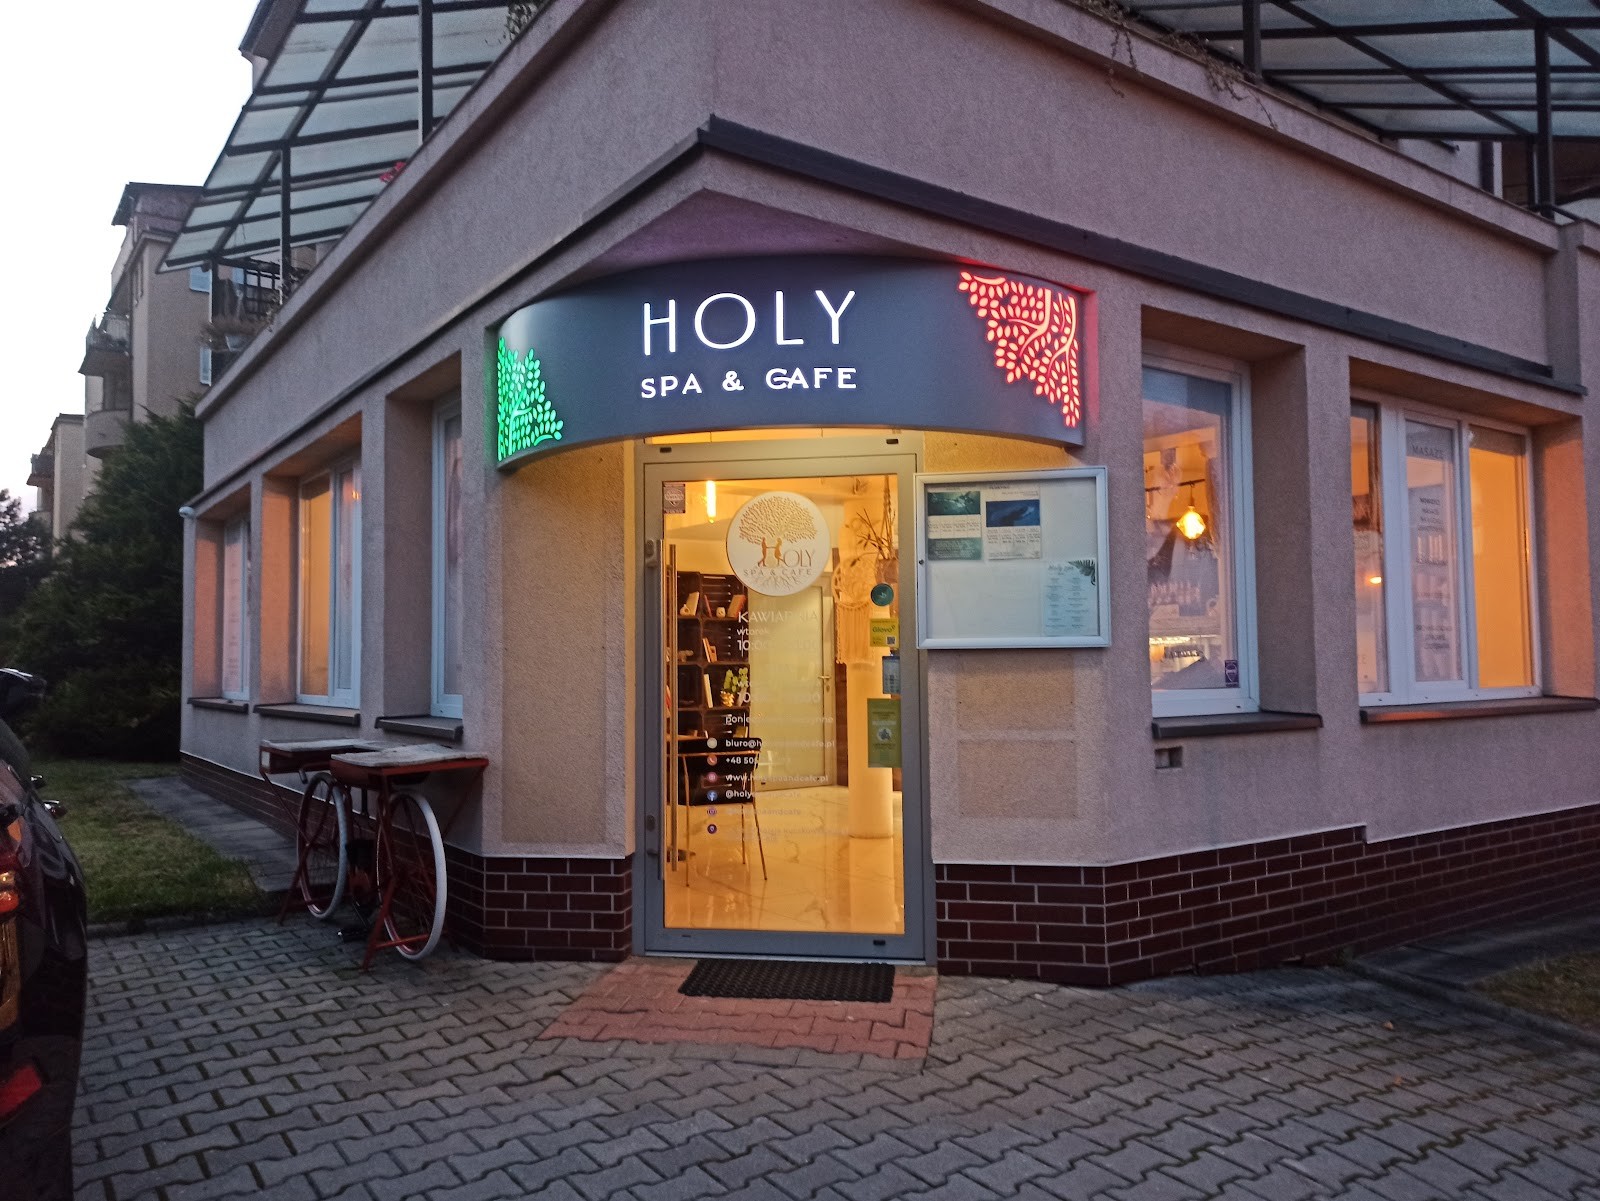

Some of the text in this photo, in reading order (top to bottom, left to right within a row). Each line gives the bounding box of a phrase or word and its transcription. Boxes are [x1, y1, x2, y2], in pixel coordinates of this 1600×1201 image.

[643, 289, 856, 356] HOLY
[640, 373, 703, 399] SPA
[721, 370, 745, 392] &
[743, 568, 764, 577] SPA
